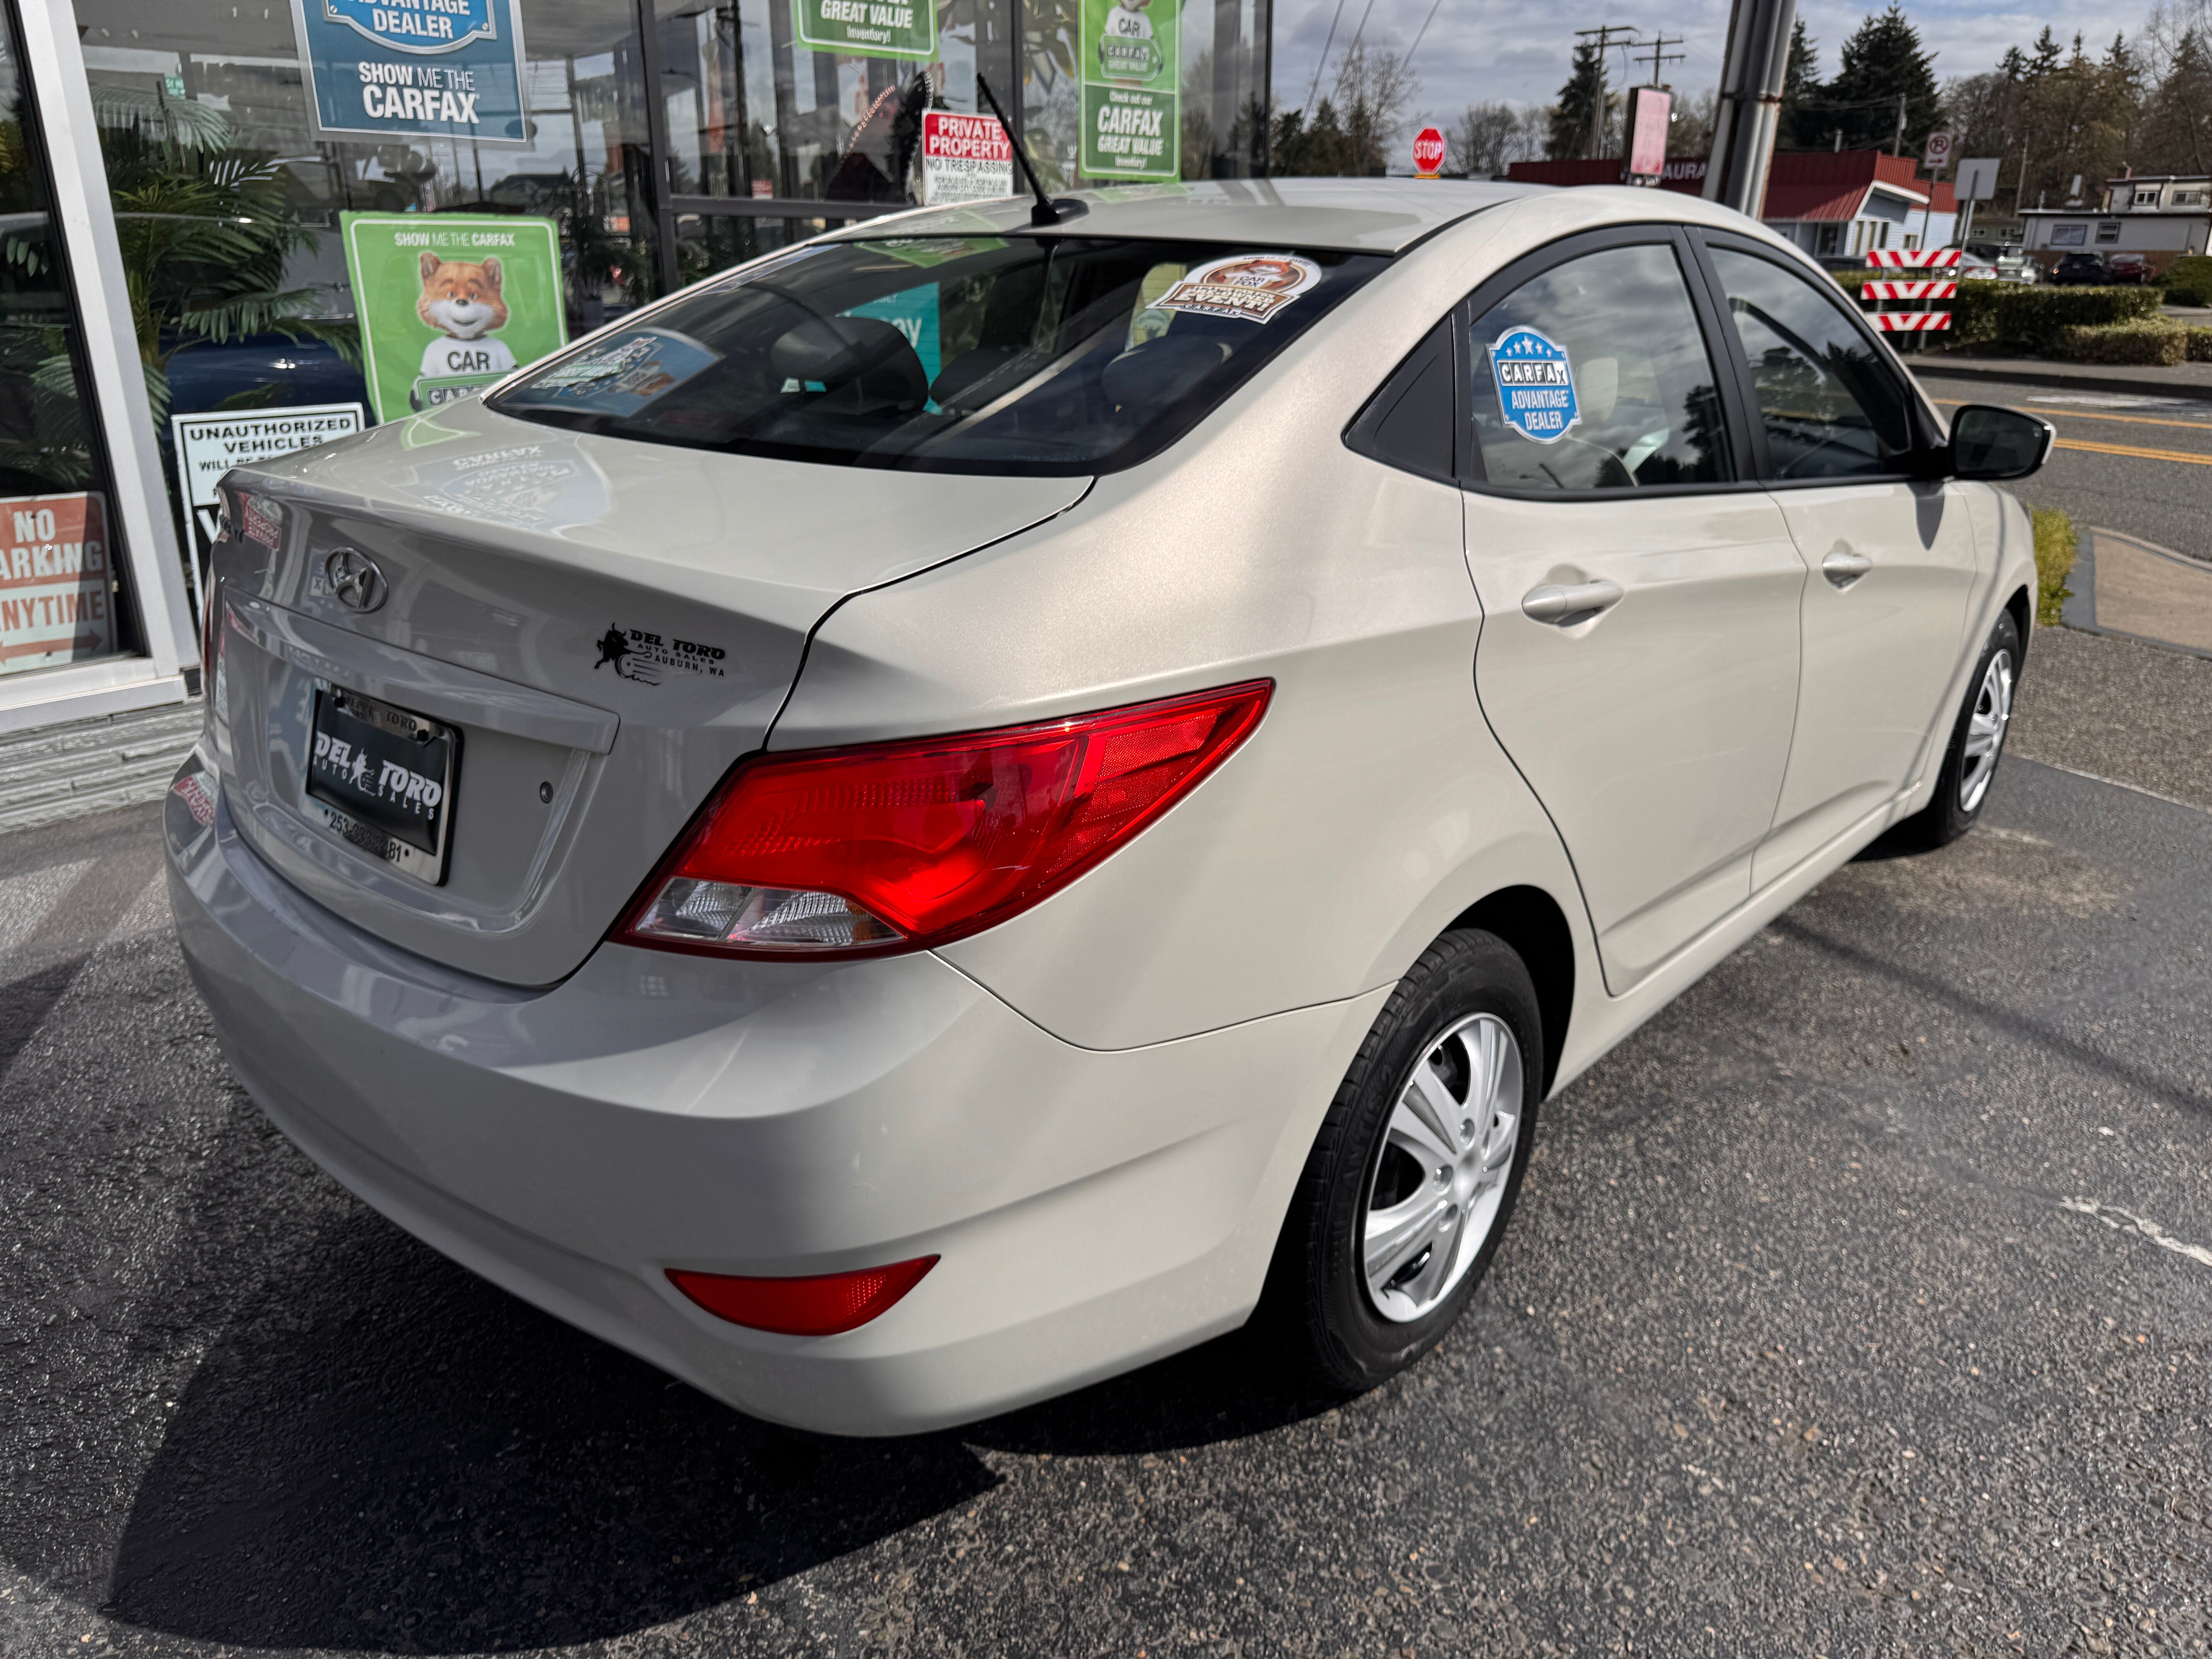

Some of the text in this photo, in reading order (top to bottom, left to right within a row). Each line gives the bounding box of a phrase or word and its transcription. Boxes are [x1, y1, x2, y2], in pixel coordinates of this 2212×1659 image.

[372, 8, 453, 39] DEALER
[820, 0, 914, 29] GREAT VALUE
[1118, 18, 1140, 36] CAR
[358, 61, 474, 91] SHOW ME THE
[362, 84, 480, 124] CARFAX
[938, 117, 1002, 140] PRIVATE
[1097, 104, 1164, 137] CARFAX
[929, 135, 1010, 159] PROPERTY
[1097, 134, 1164, 156] GREAT VALUE
[1414, 140, 1443, 161] STOP
[926, 158, 1013, 175] NO TRESPASSING
[394, 232, 515, 247] SHOW ME THE CARFAX
[1174, 293, 1271, 311] EVENT!
[1185, 304, 1242, 315] CARFAX
[447, 351, 490, 371] CAR
[1501, 364, 1565, 384] CARFAX
[1511, 390, 1568, 409] ADVANTAGE
[190, 417, 350, 441] UNAUTHORIZED
[1524, 411, 1563, 431] DEALER
[223, 434, 323, 453] VEHICLES
[199, 458, 230, 472] WILL
[14, 508, 57, 544] NO
[0, 540, 104, 580] ARKING
[0, 590, 105, 633] NYTIME
[630, 629, 725, 660] DEL TORO
[638, 643, 714, 665] AUTO SALES
[654, 655, 725, 677] AUBURN, WA
[314, 731, 442, 808] DEL TORO
[313, 758, 434, 821] AUTO SALES
